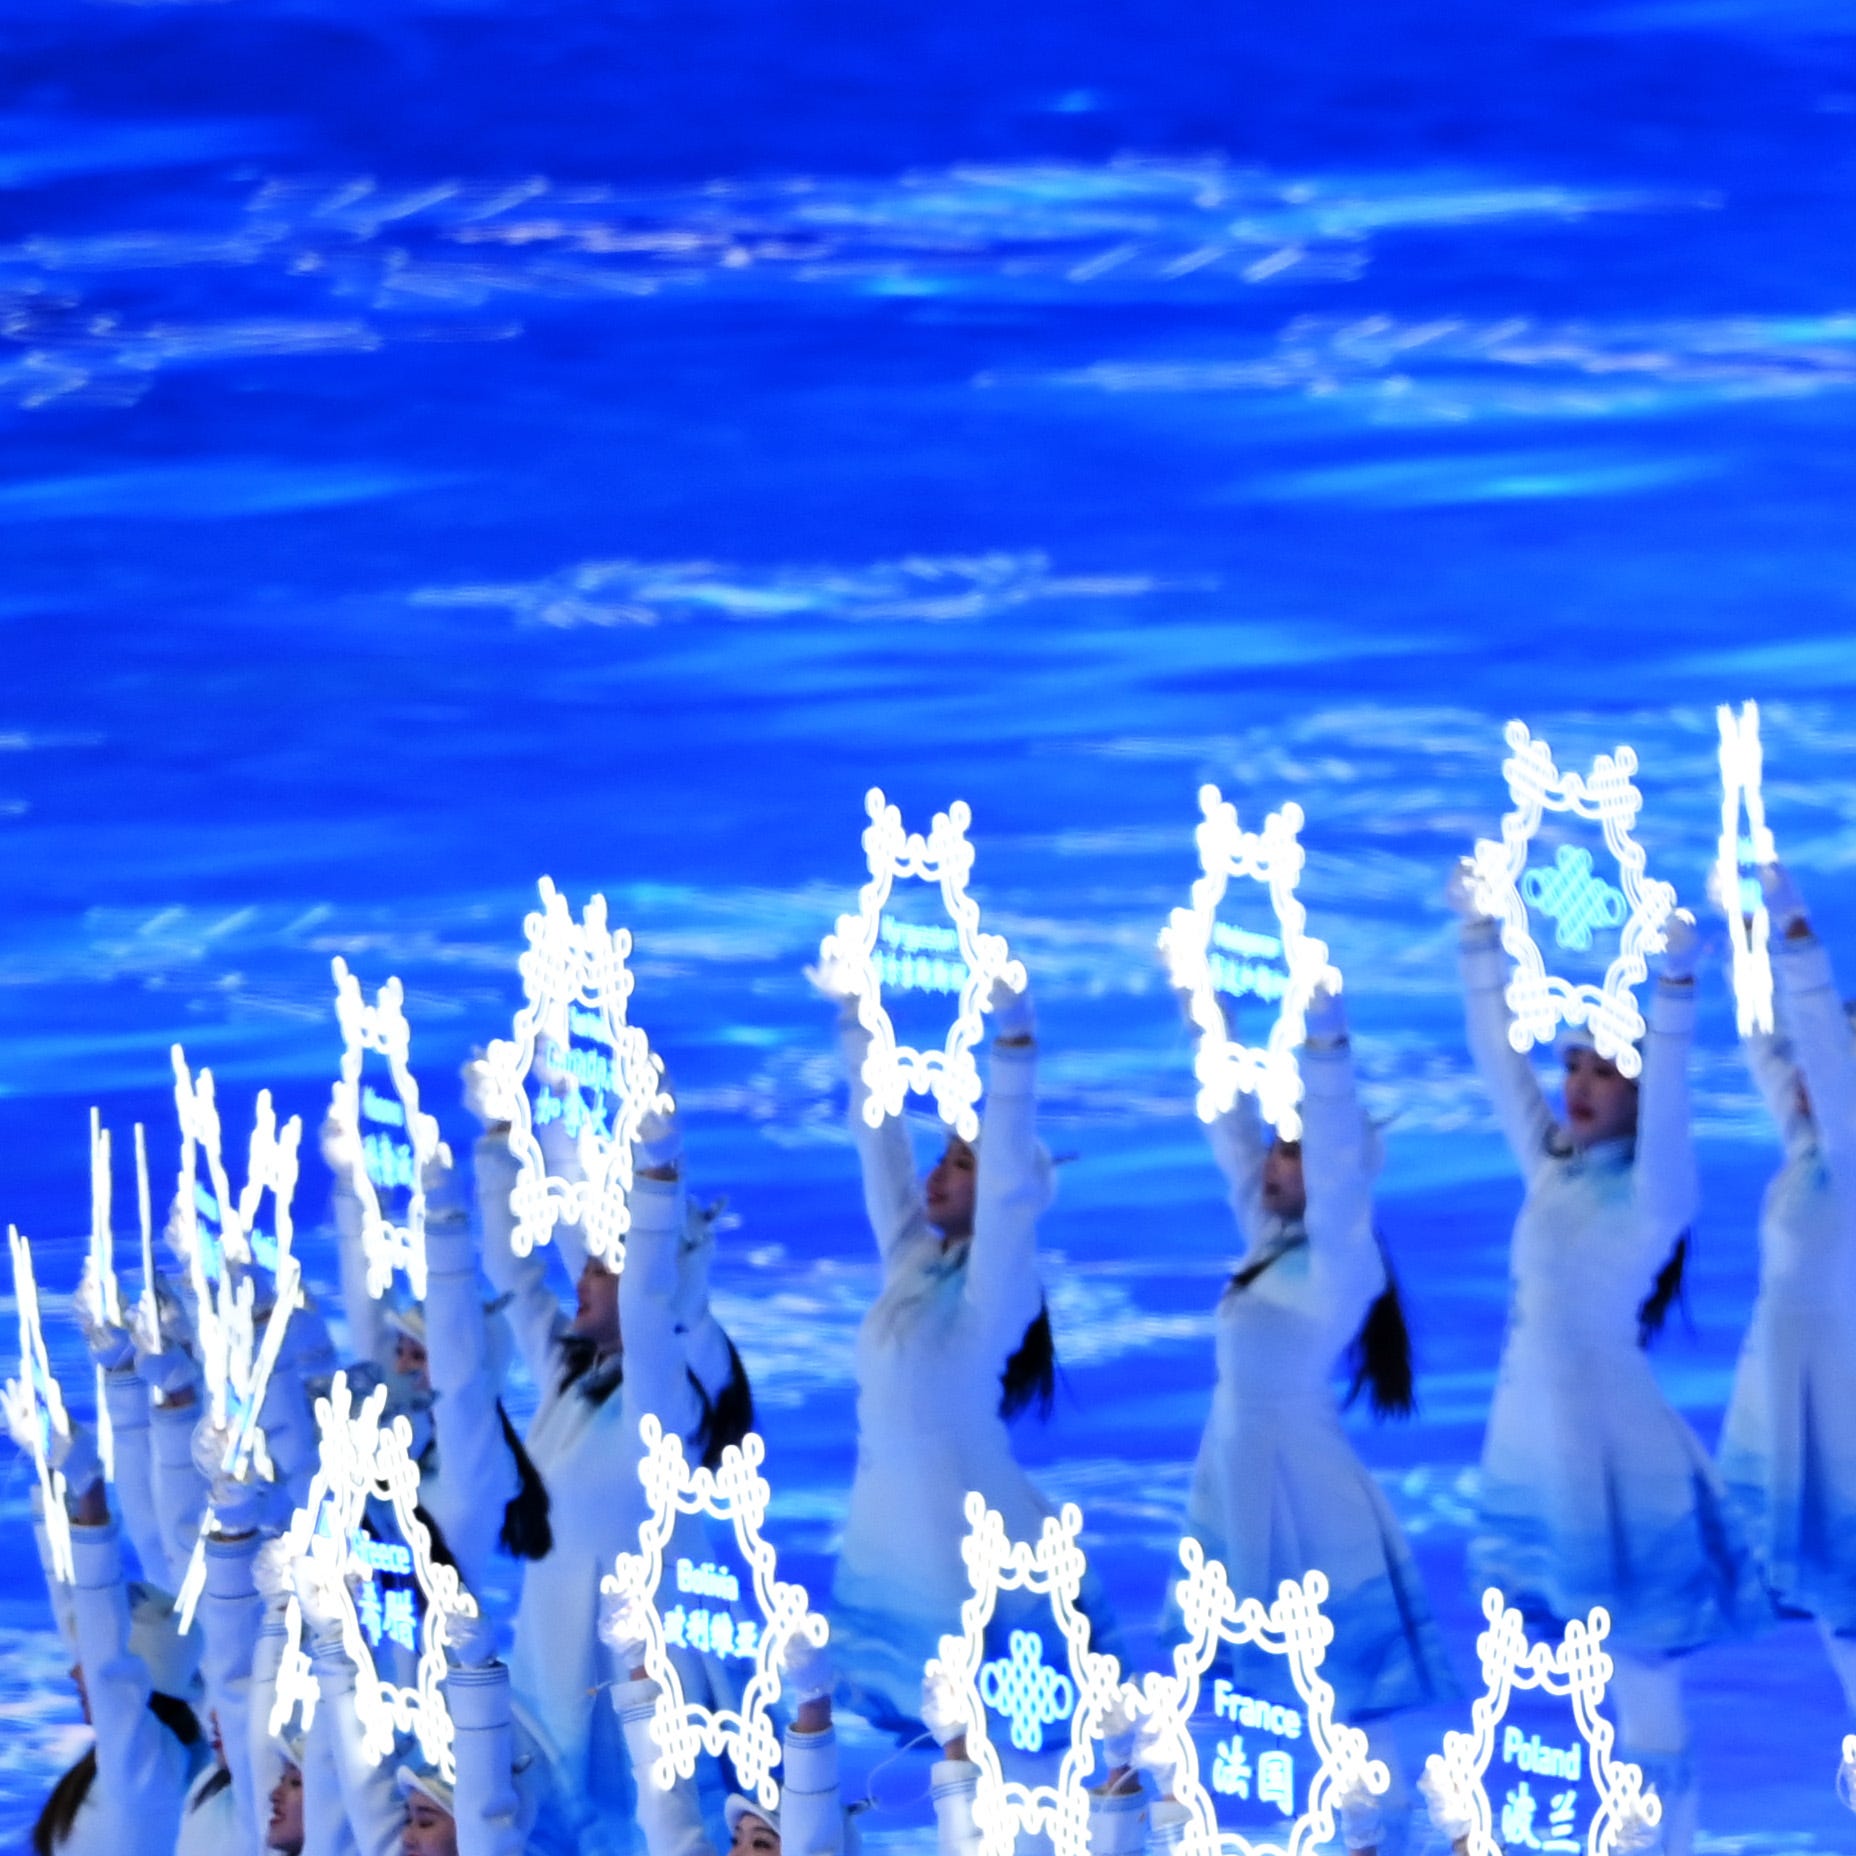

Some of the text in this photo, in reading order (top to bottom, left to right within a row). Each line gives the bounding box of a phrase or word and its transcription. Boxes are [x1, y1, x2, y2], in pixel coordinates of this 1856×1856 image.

[1214, 1678, 1302, 1739] France
[1212, 1734, 1294, 1817] 法国
[1503, 1725, 1581, 1781] Poland
[1502, 1781, 1582, 1854] 波兰
